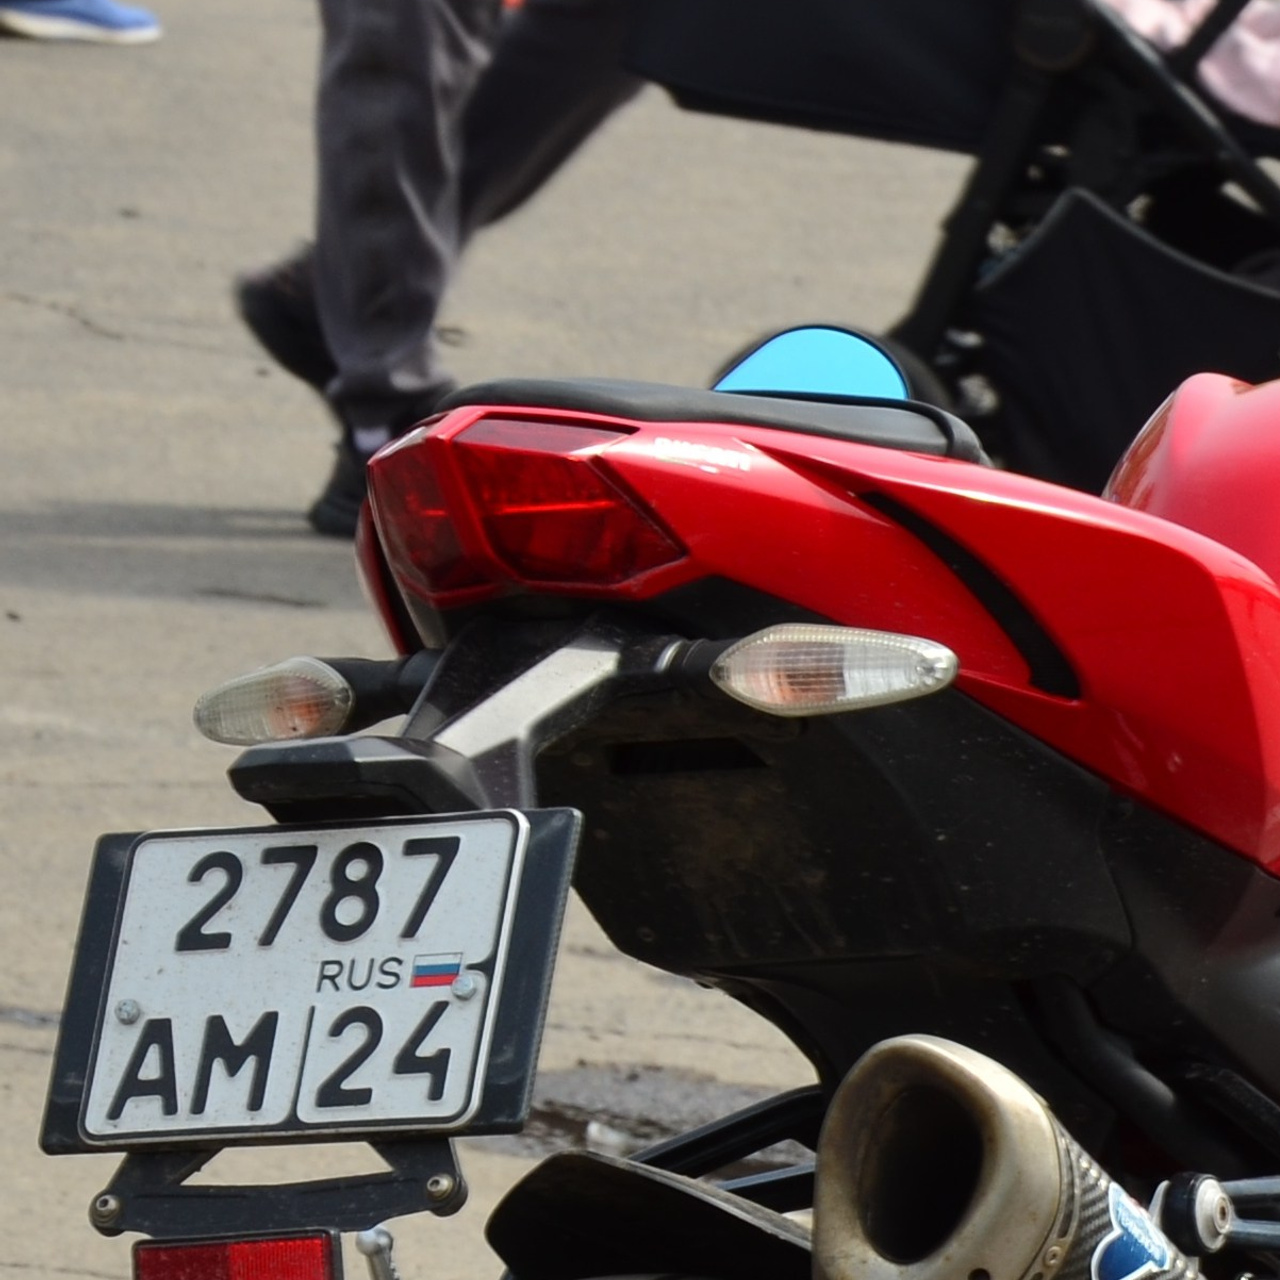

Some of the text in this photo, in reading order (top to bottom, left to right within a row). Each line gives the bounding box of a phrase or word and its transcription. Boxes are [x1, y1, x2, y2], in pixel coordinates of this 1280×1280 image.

[174, 836, 461, 952] 2787
[315, 957, 404, 992] RUS
[106, 1000, 451, 1121] AM 24
